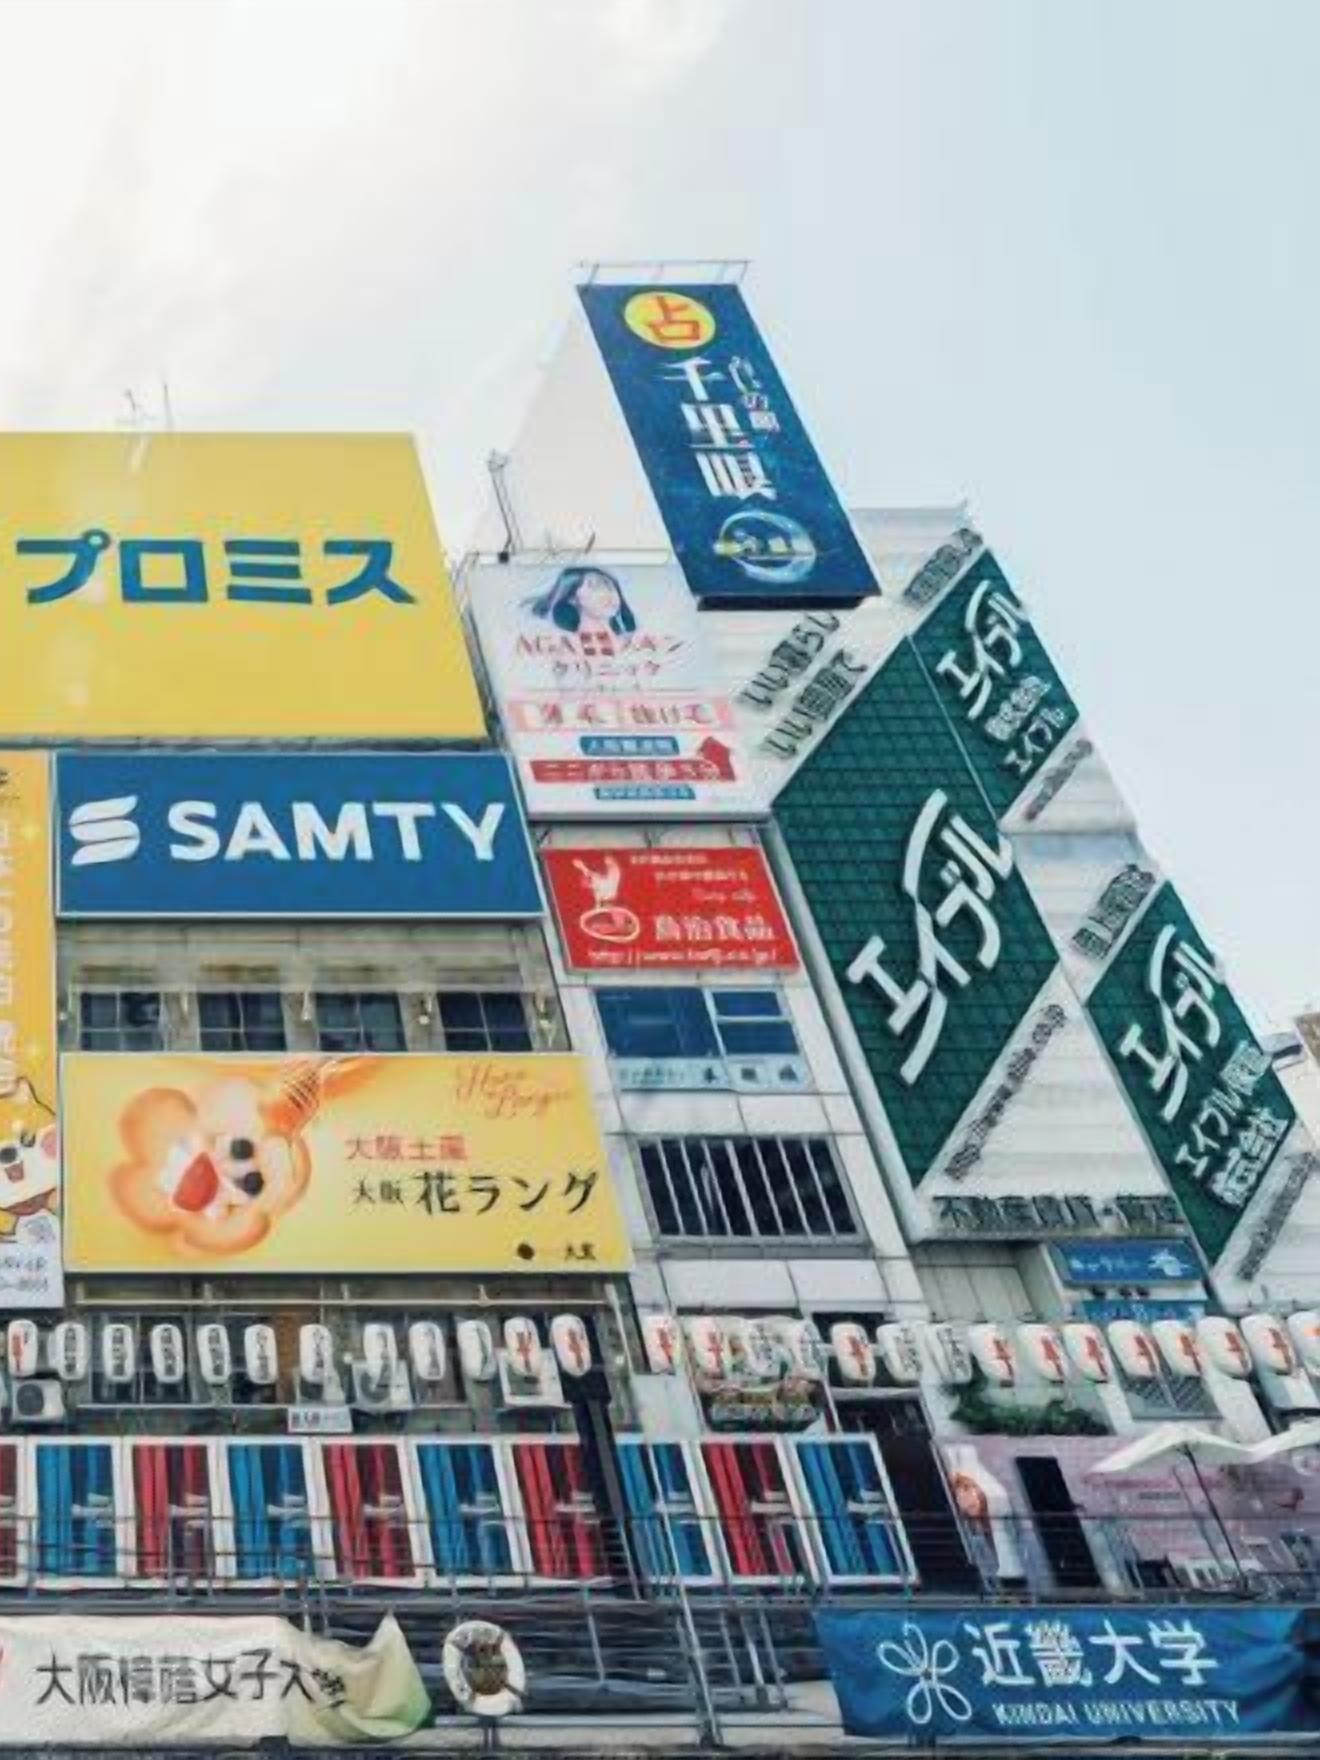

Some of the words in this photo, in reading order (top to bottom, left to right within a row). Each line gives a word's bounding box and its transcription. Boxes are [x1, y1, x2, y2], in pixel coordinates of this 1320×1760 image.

[647, 295, 701, 340] 占
[16, 528, 418, 606] プロミス
[936, 579, 1030, 719] エイブル
[167, 800, 505, 863] SAMTY
[846, 788, 1013, 1085] エイブル
[1119, 924, 1227, 1123] エイブル
[964, 1619, 1220, 1685] 近畿大学
[992, 1702, 1076, 1725] KINDAI
[1084, 1700, 1241, 1725] UNIVERSITY
